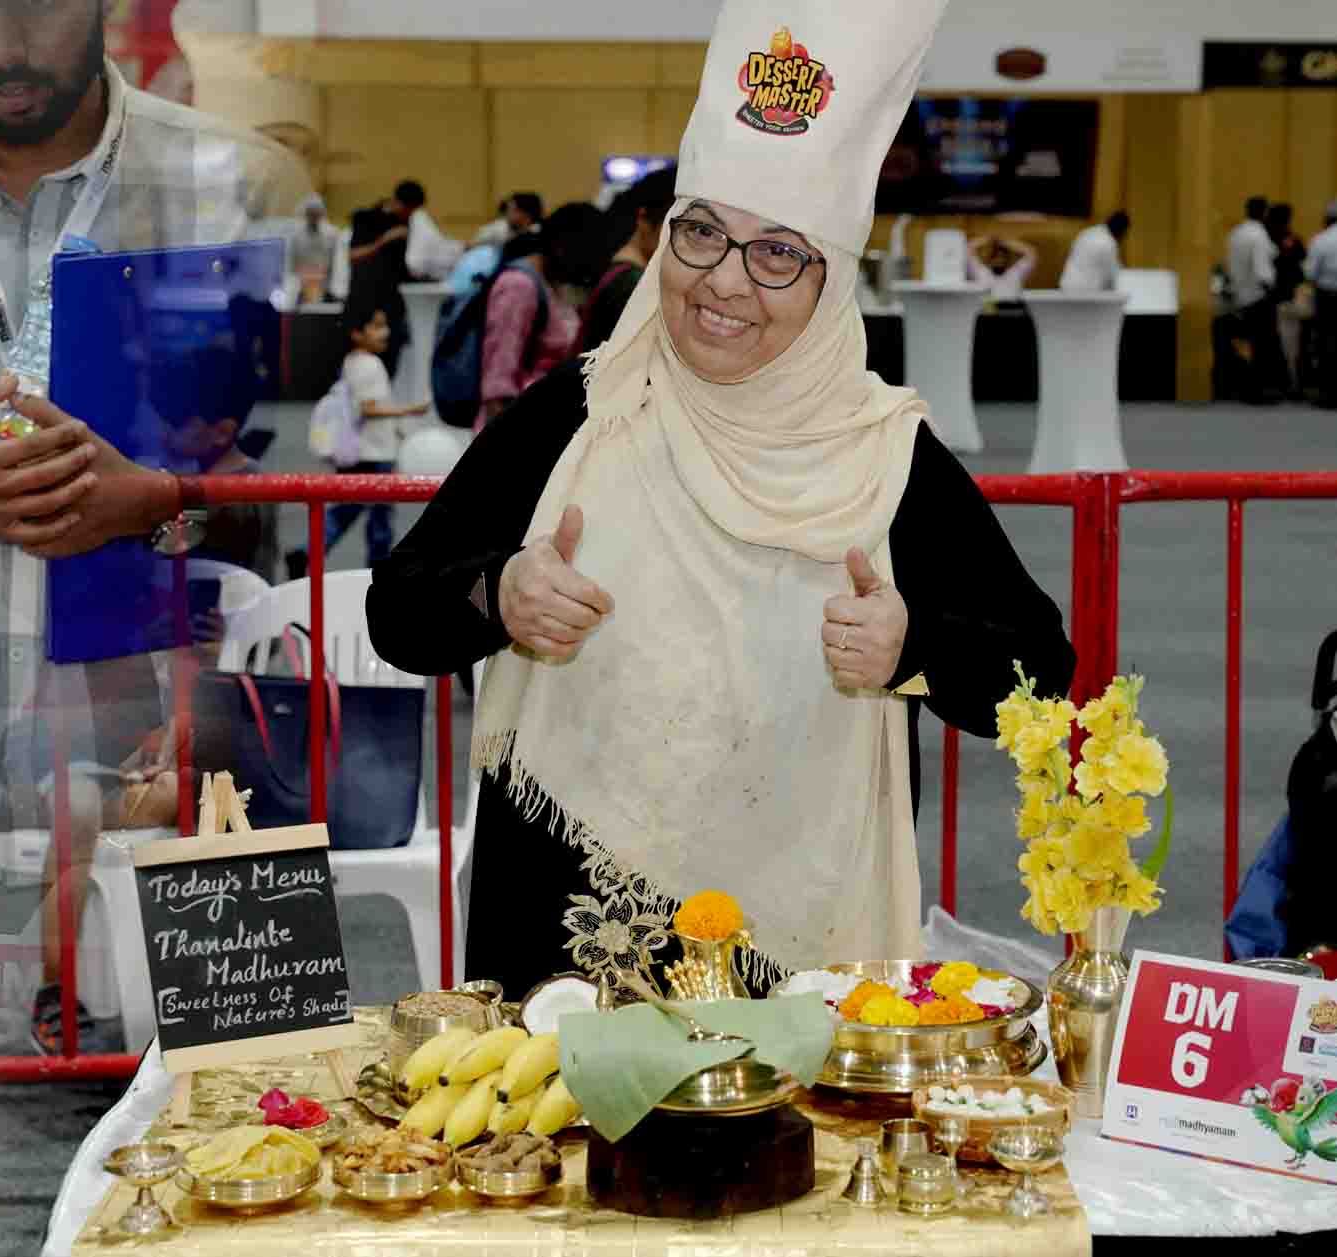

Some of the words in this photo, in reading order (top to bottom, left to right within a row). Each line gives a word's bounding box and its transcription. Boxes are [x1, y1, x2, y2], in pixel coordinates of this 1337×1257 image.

[748, 53, 824, 91] DESSERT
[751, 84, 823, 118] MASTER
[148, 869, 242, 922] Today's
[250, 861, 325, 890] Menu
[154, 920, 293, 960] Thanalinte
[206, 953, 345, 986] Madhuram
[269, 985, 294, 1004] Of
[1163, 982, 1239, 1032] DM
[213, 1003, 295, 1031] Nature's
[1171, 1031, 1212, 1088] 6
